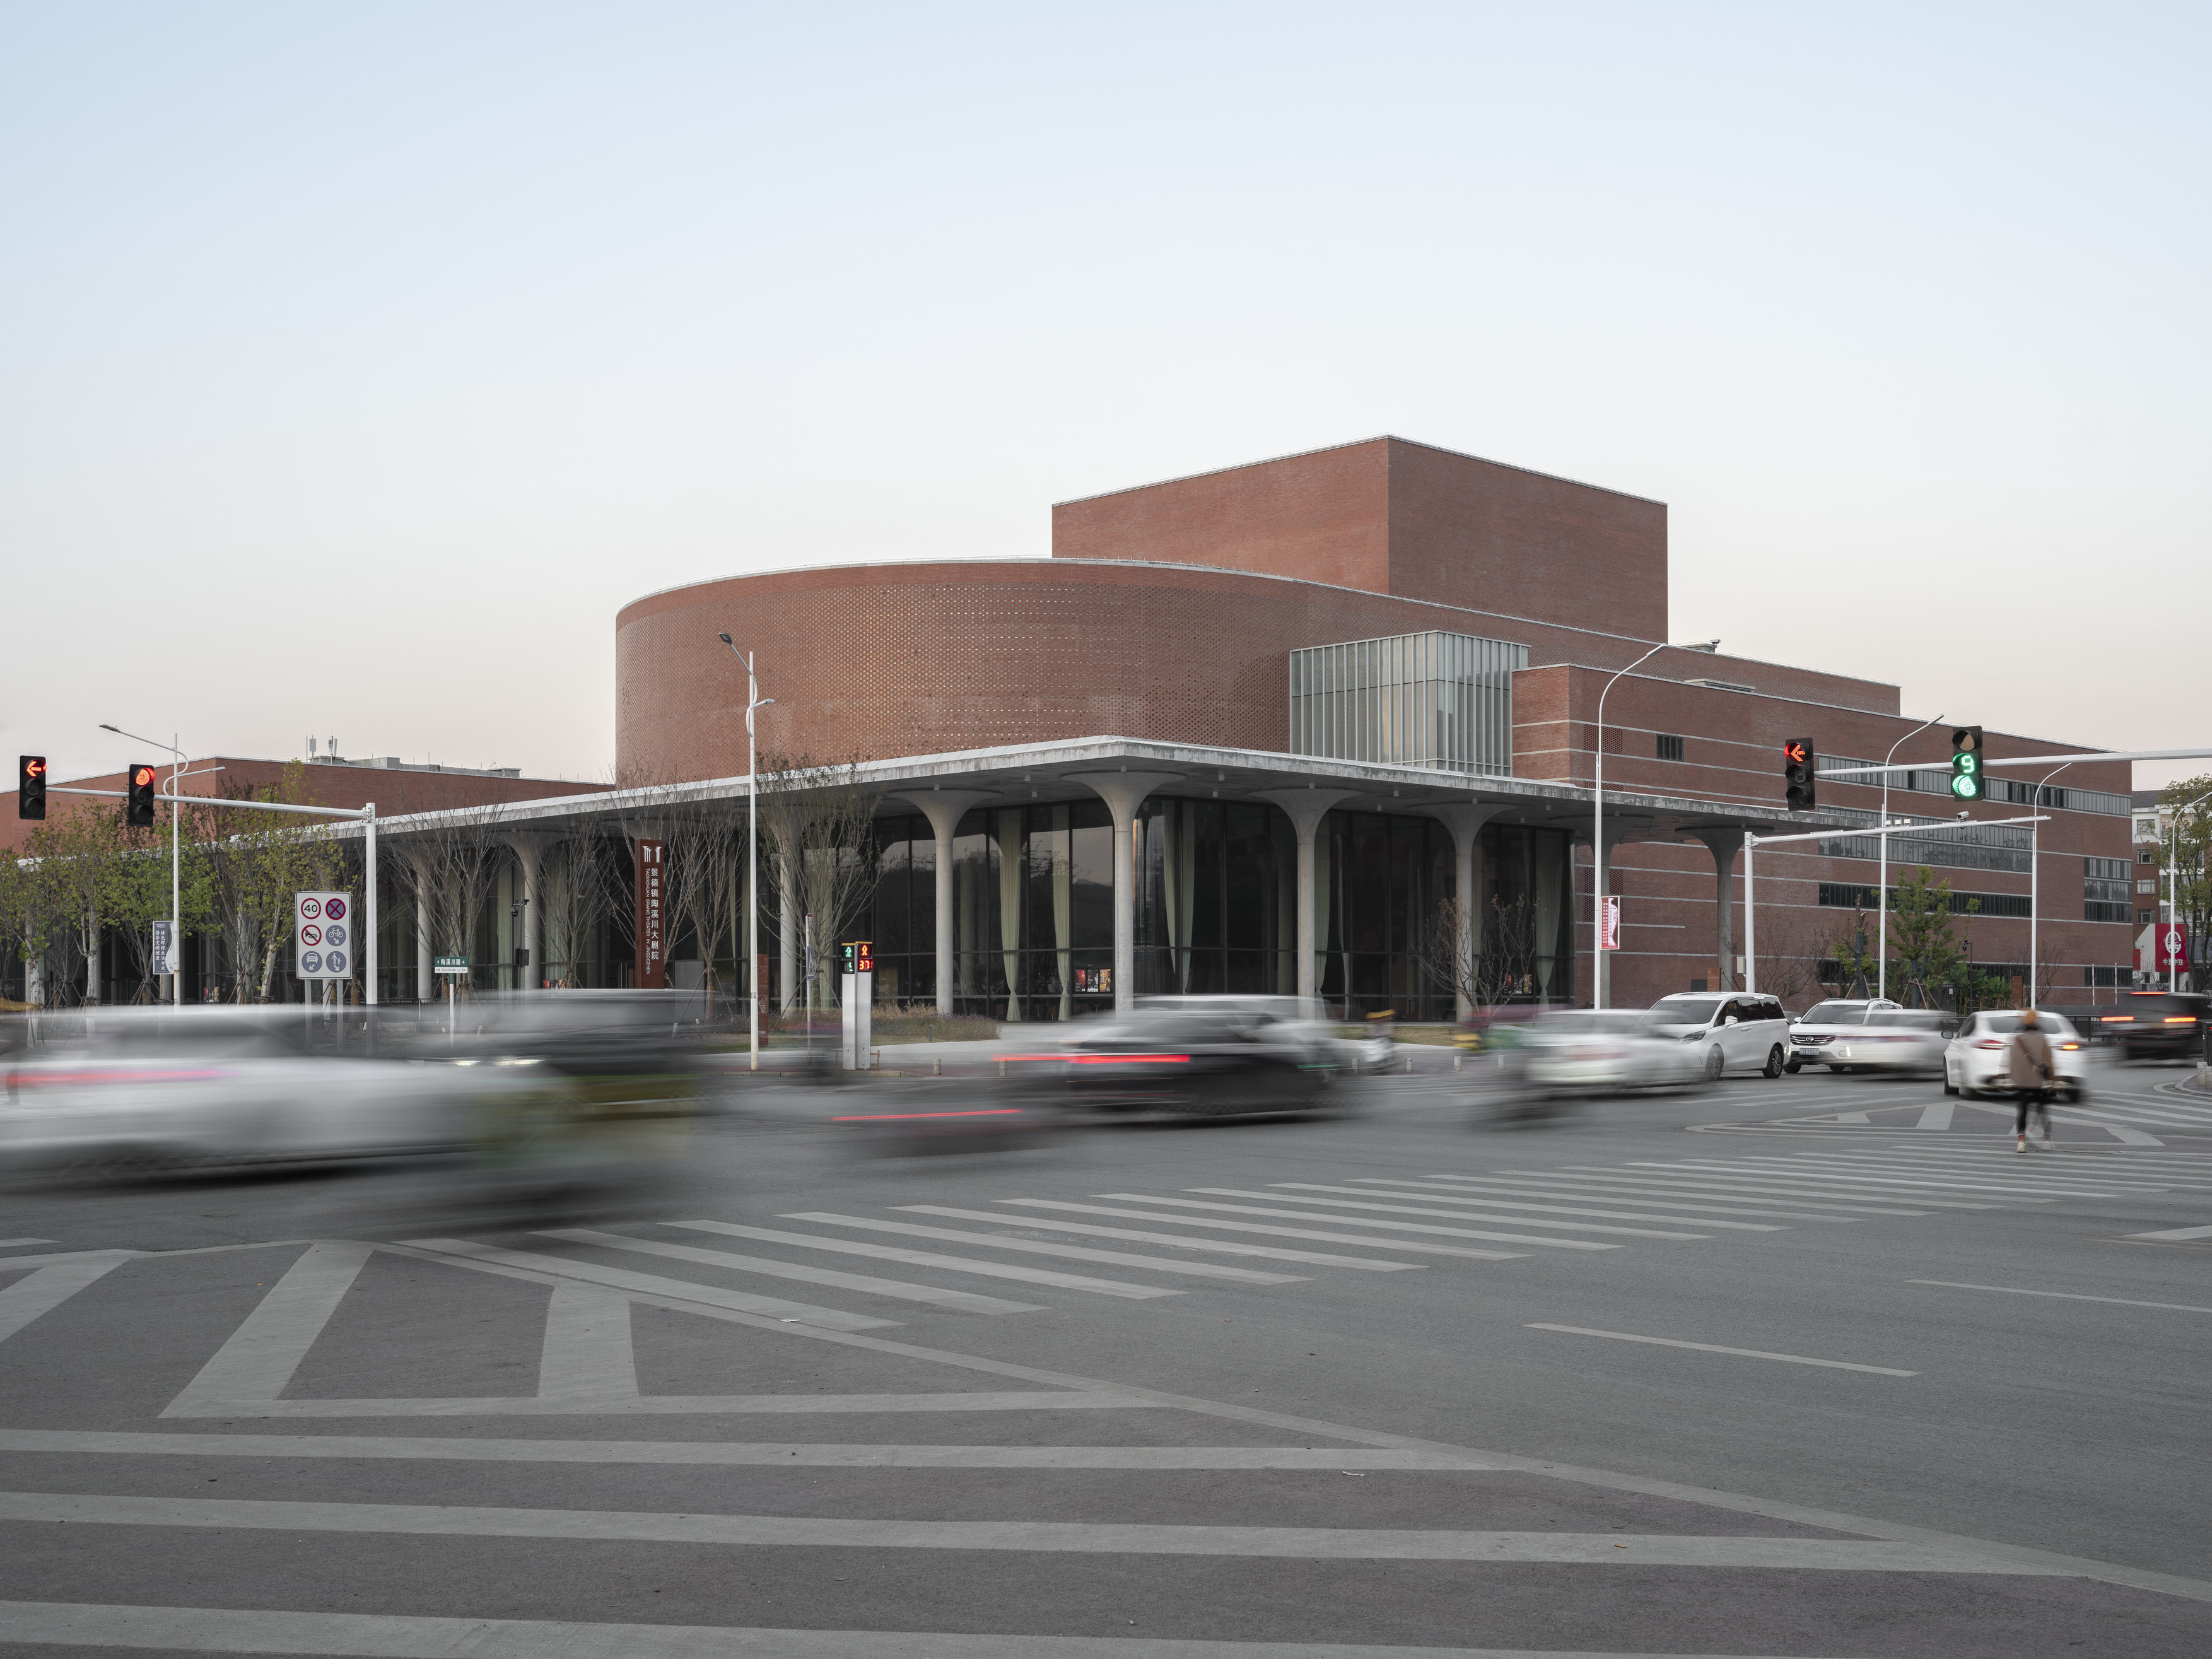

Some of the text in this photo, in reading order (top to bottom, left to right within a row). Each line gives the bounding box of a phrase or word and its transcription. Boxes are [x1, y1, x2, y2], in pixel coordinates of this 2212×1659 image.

[1962, 755, 1974, 773] 9
[304, 904, 318, 913] 40
[651, 868, 659, 959] 景德镇陶溪川大剧院
[859, 960, 870, 970] 37
